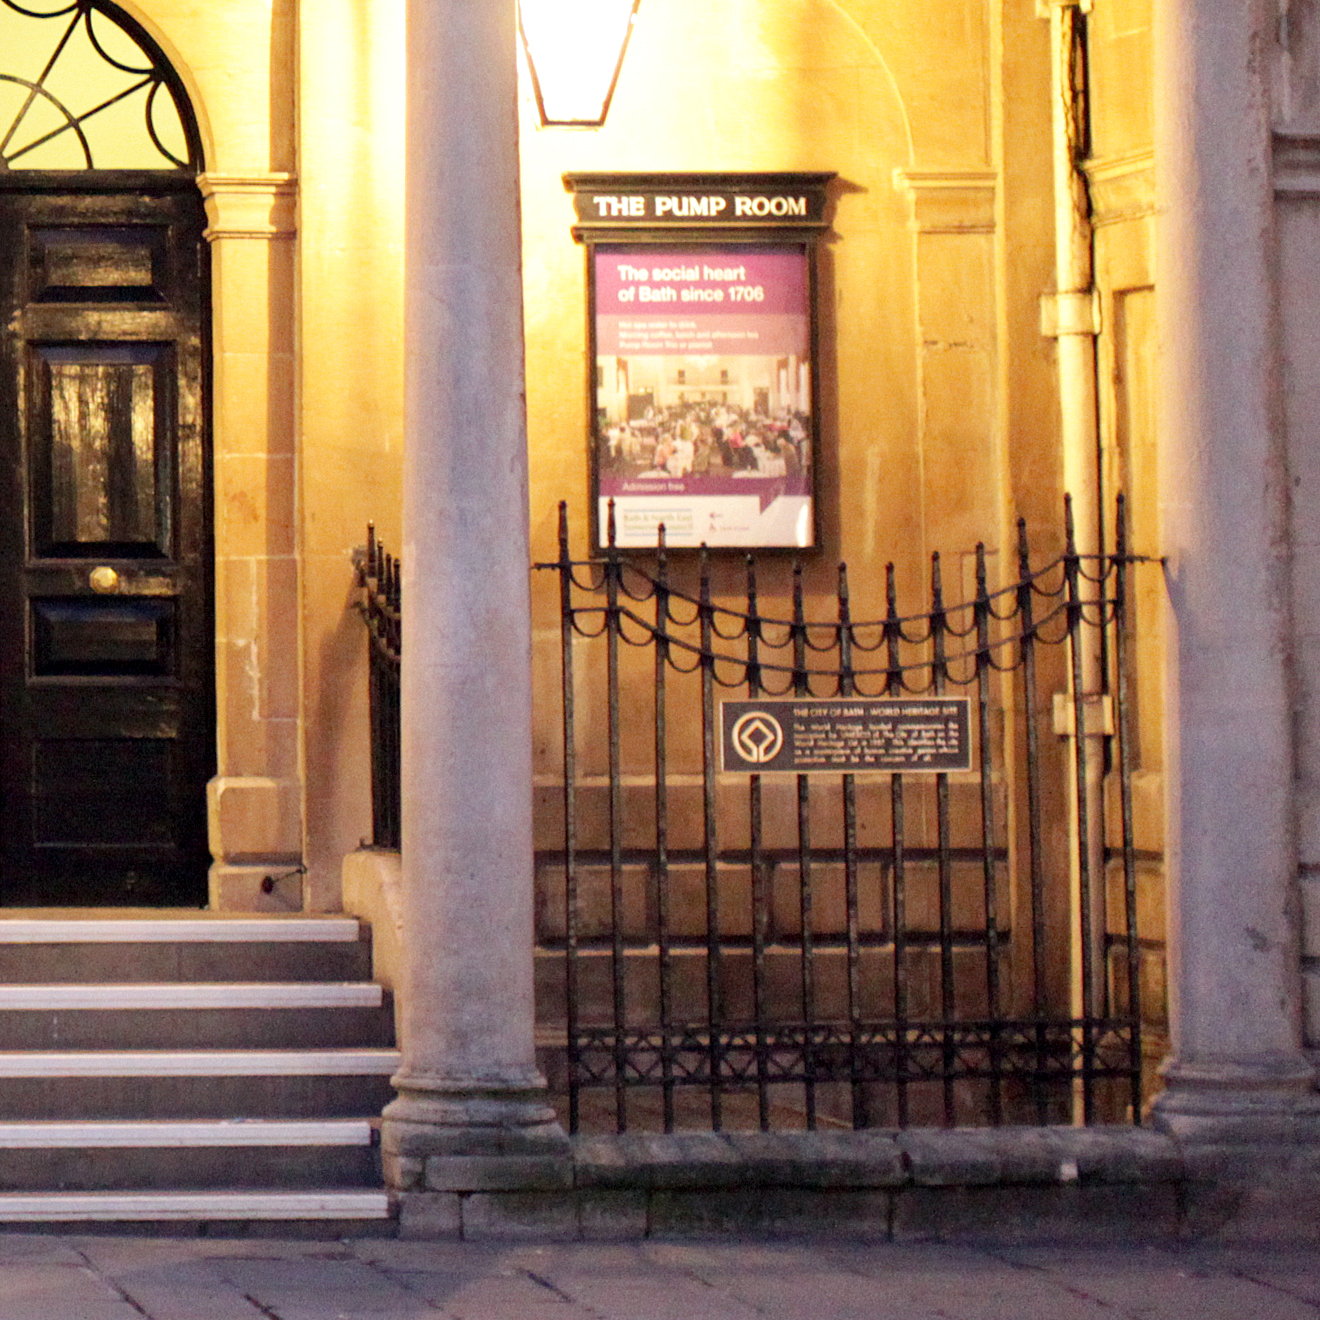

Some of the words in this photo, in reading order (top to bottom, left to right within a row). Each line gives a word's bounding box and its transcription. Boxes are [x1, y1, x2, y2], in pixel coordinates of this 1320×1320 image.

[593, 196, 645, 216] THE
[655, 196, 726, 216] PUMP
[734, 196, 807, 216] ROOM
[618, 265, 649, 282] The
[652, 265, 700, 282] social
[703, 265, 746, 282] heart
[618, 285, 636, 302] of
[639, 285, 678, 302] Bath
[681, 285, 725, 302] since
[728, 285, 765, 302] 1706
